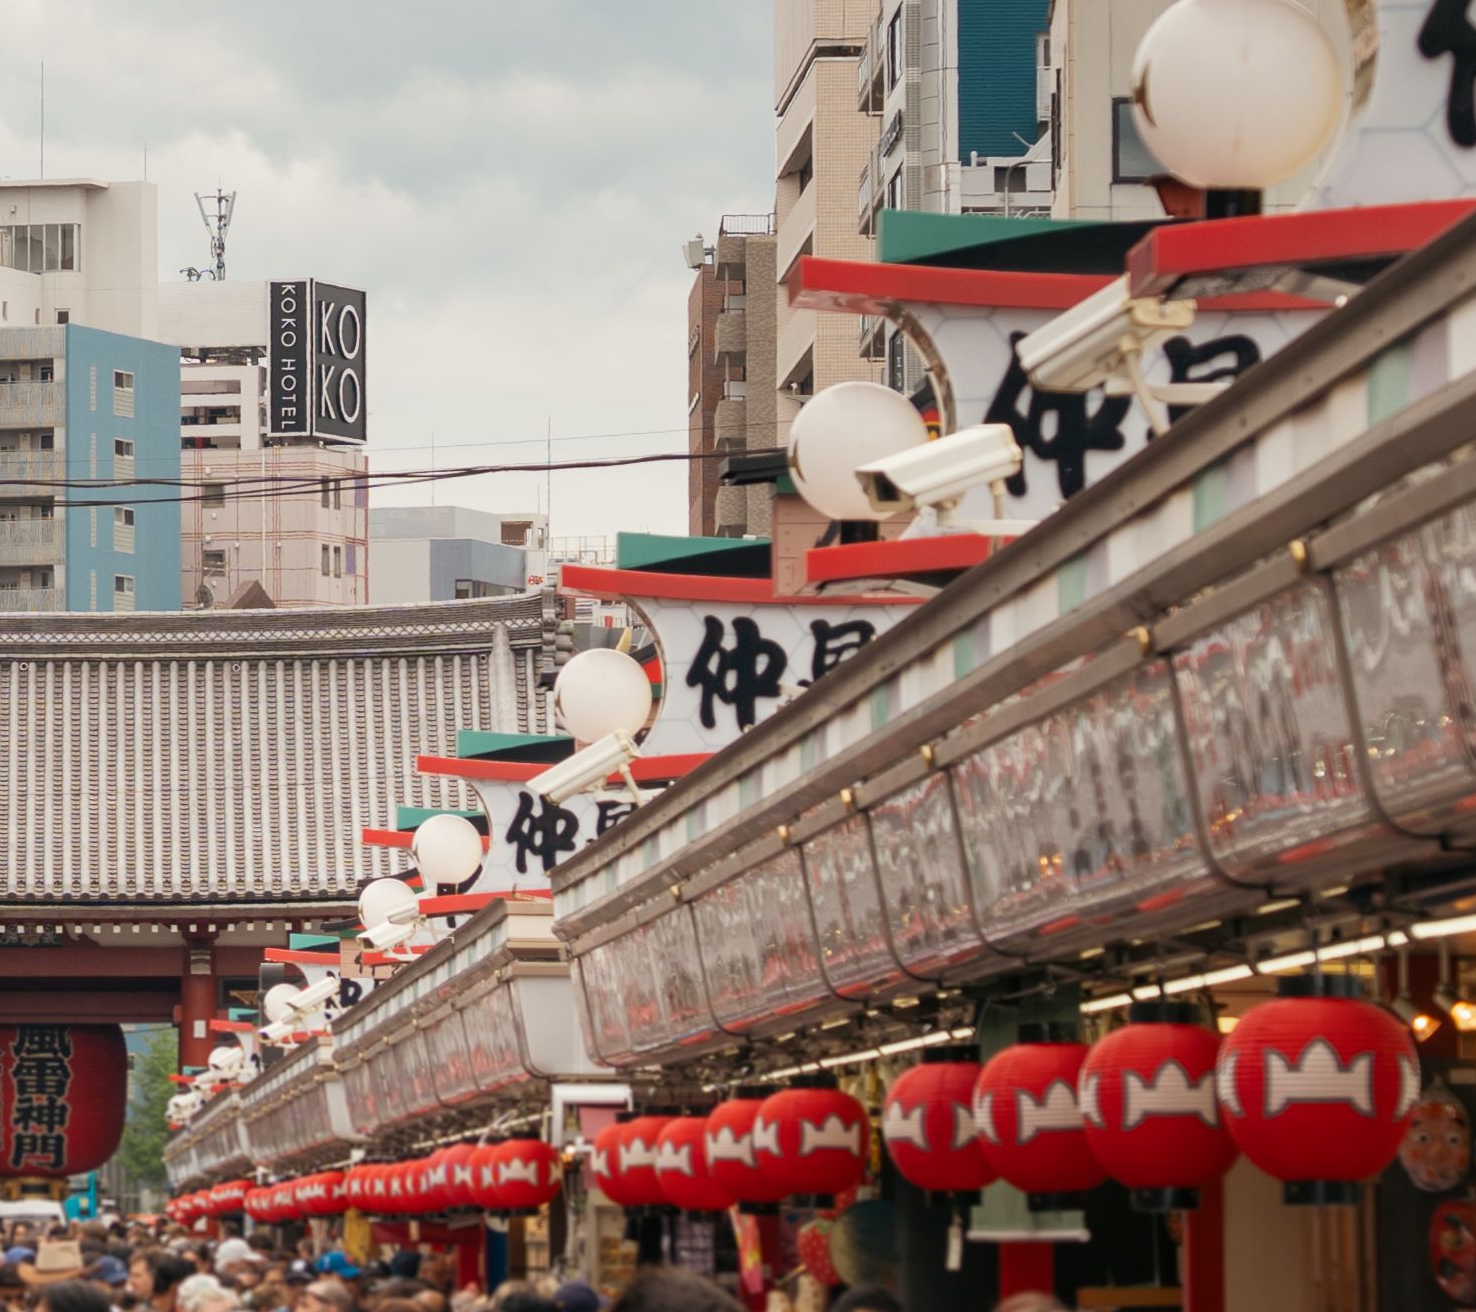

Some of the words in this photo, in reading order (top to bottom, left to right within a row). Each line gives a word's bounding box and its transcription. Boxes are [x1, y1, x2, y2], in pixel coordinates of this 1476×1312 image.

[281, 284, 297, 347] KOKO
[321, 300, 361, 360] KO
[281, 358, 297, 429] HOTEL
[321, 364, 361, 424] KO
